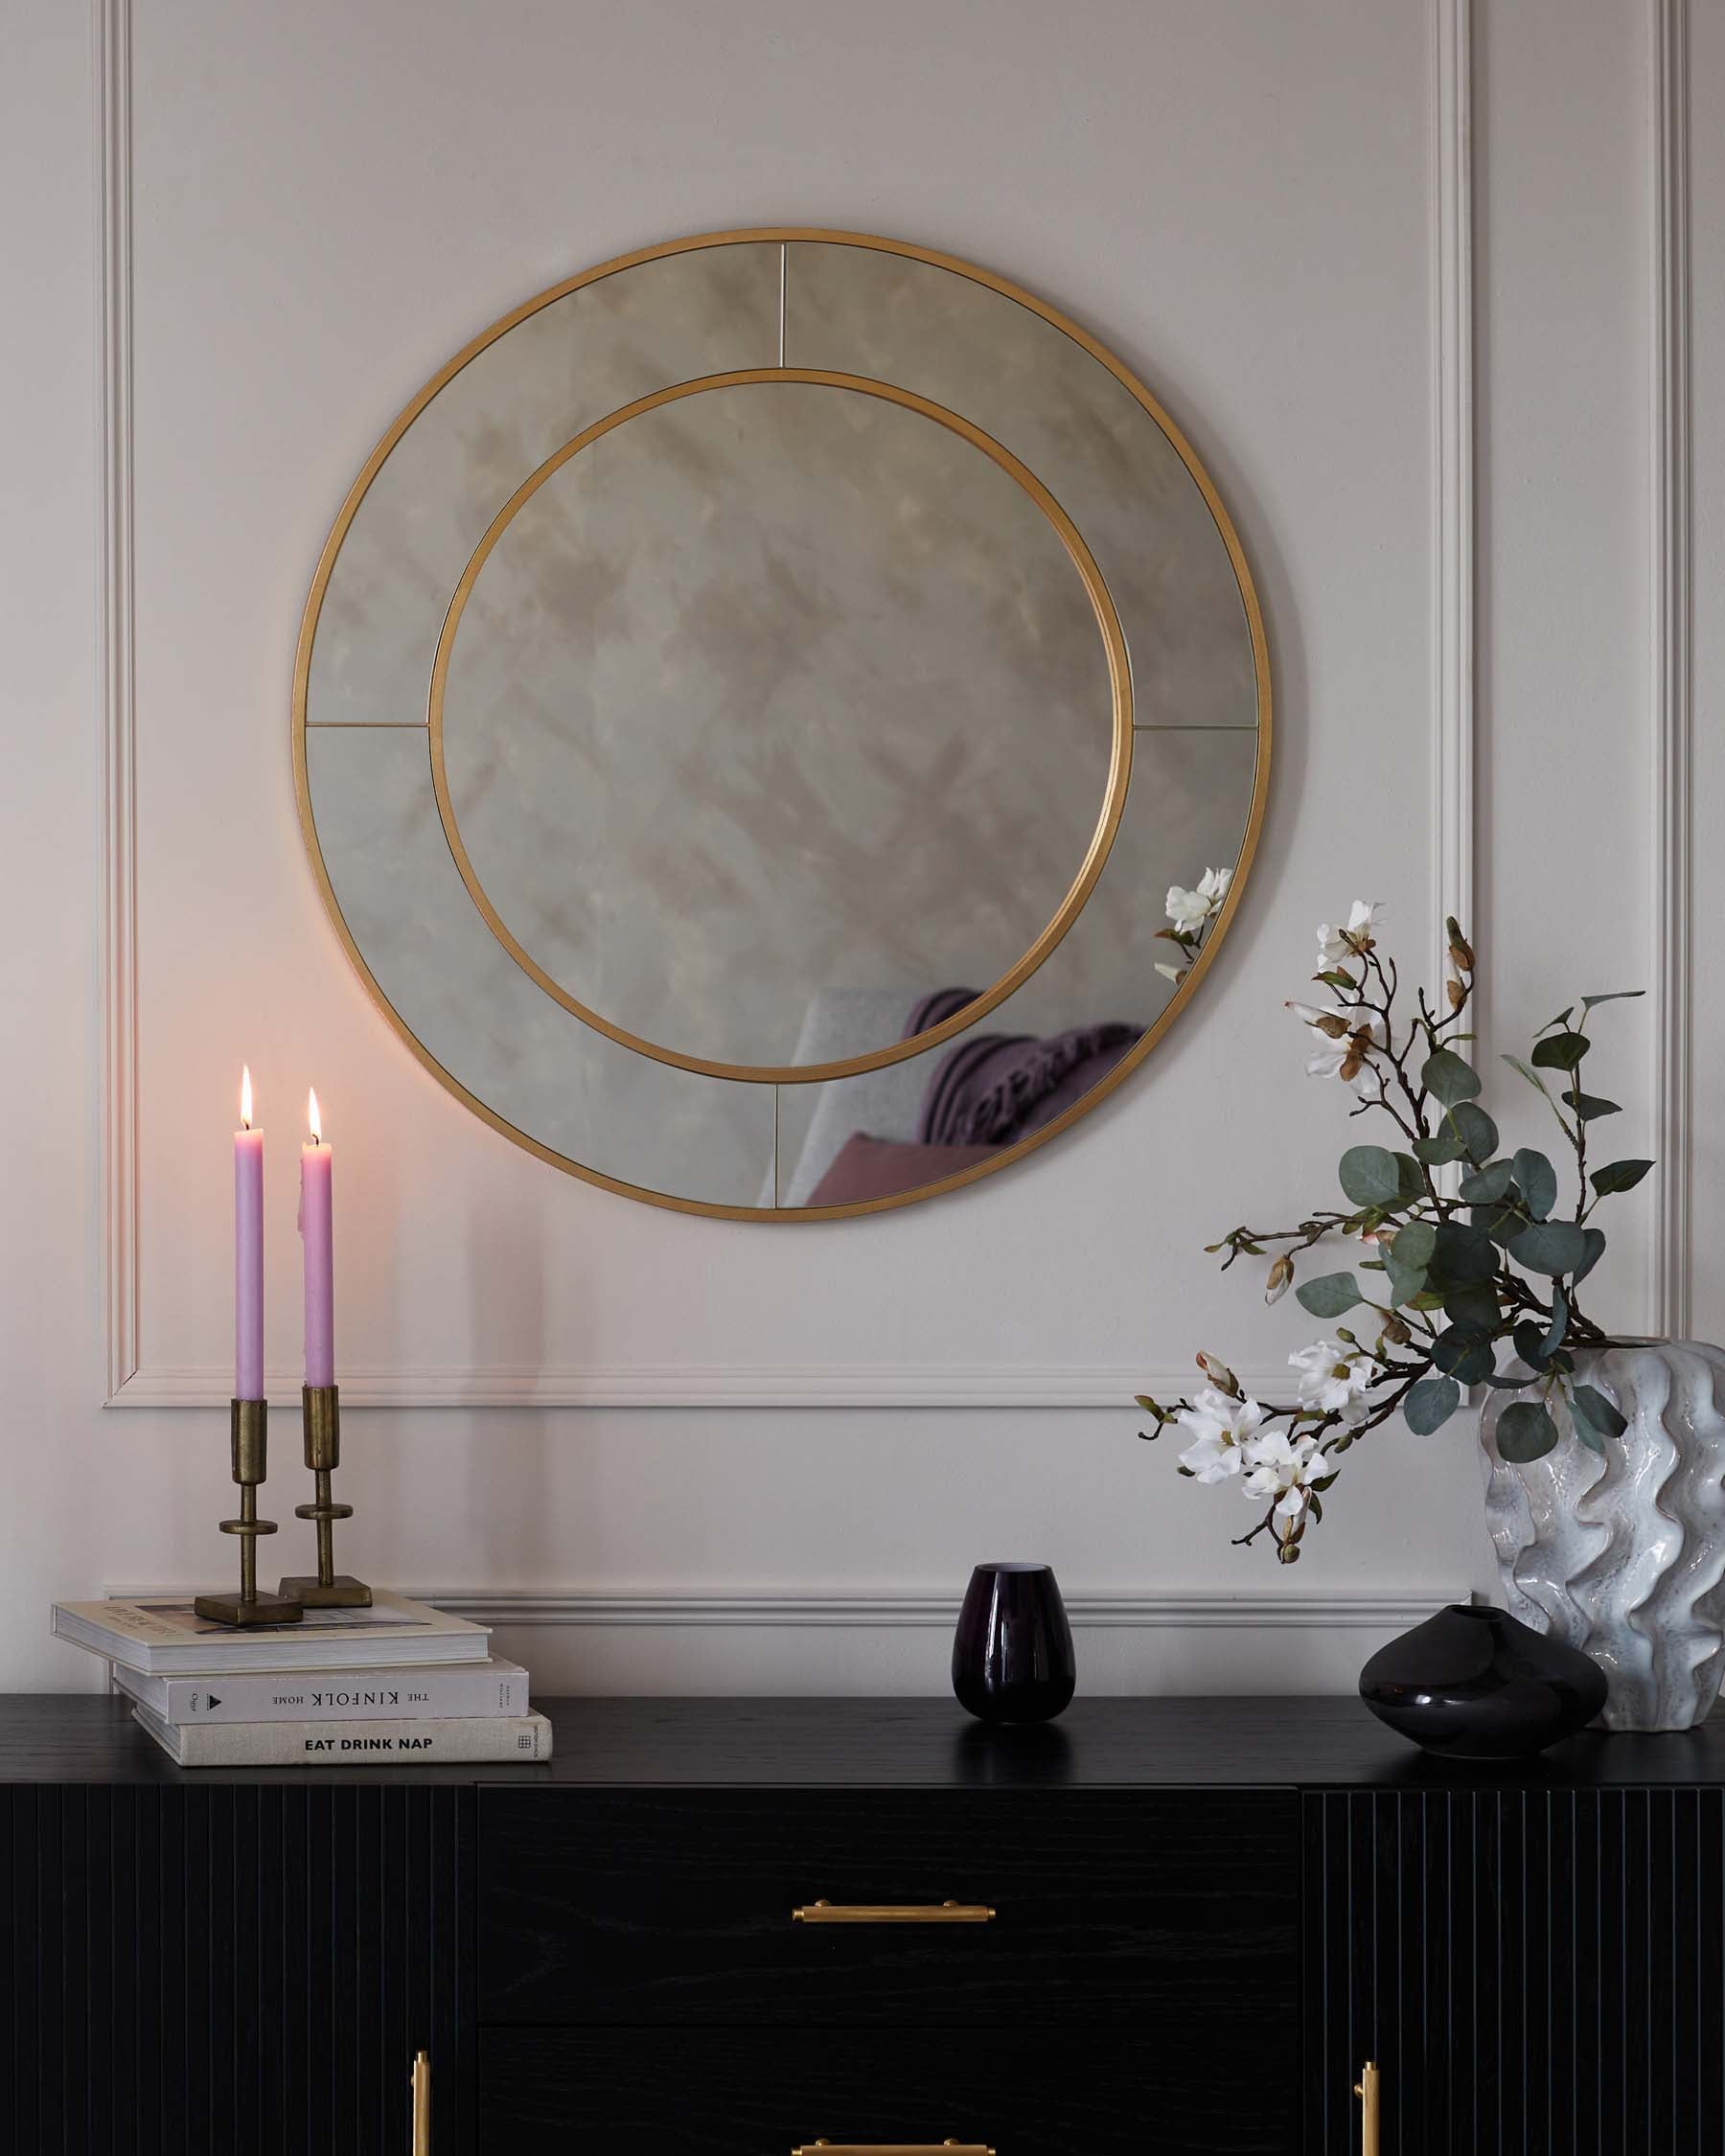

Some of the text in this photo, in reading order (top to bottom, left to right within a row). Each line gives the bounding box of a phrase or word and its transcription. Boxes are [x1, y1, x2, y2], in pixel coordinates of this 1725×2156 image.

[272, 1691, 429, 1706] THE KINFOLK HOME
[305, 1738, 433, 1751] EAT DRINK NAP
